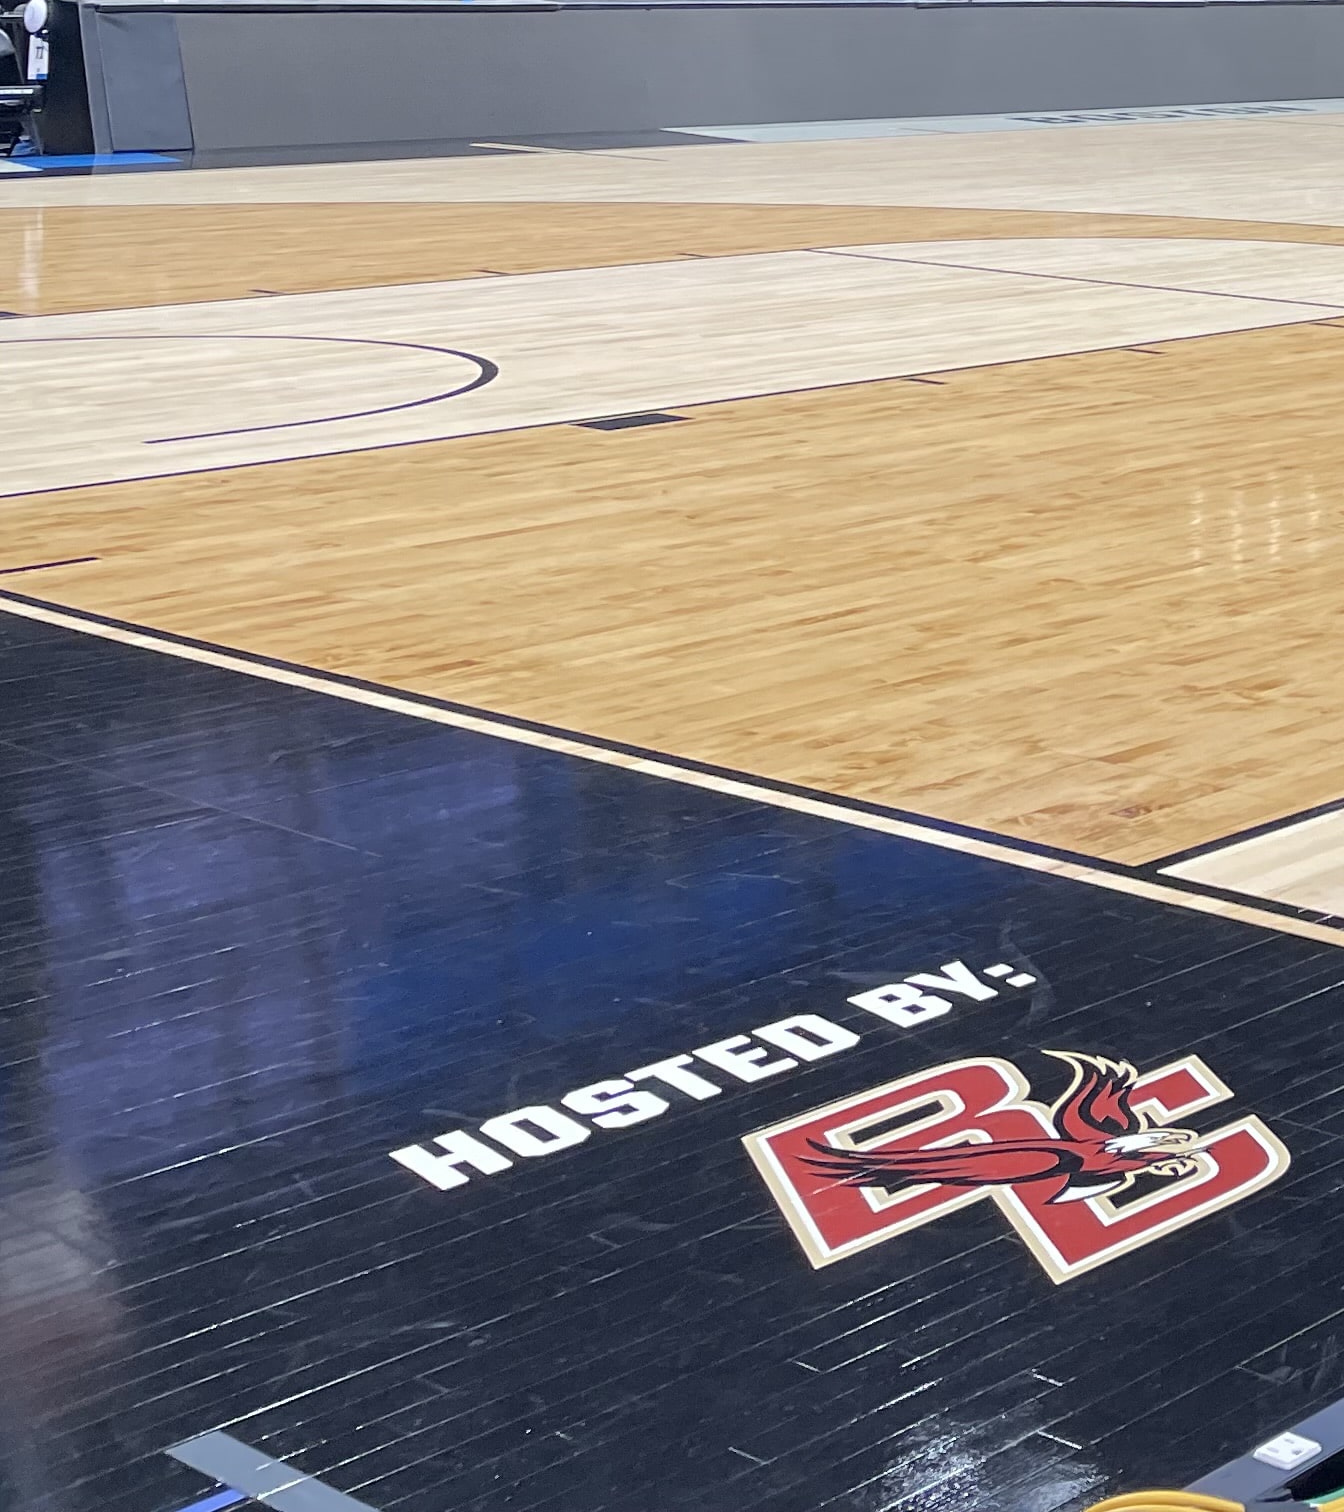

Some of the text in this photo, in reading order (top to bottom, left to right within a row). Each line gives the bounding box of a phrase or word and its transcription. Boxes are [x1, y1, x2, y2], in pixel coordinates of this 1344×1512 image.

[1006, 104, 1316, 124] BOSTON
[389, 959, 1038, 1191] HOSTED BY:
[742, 1053, 1291, 1286] BC
